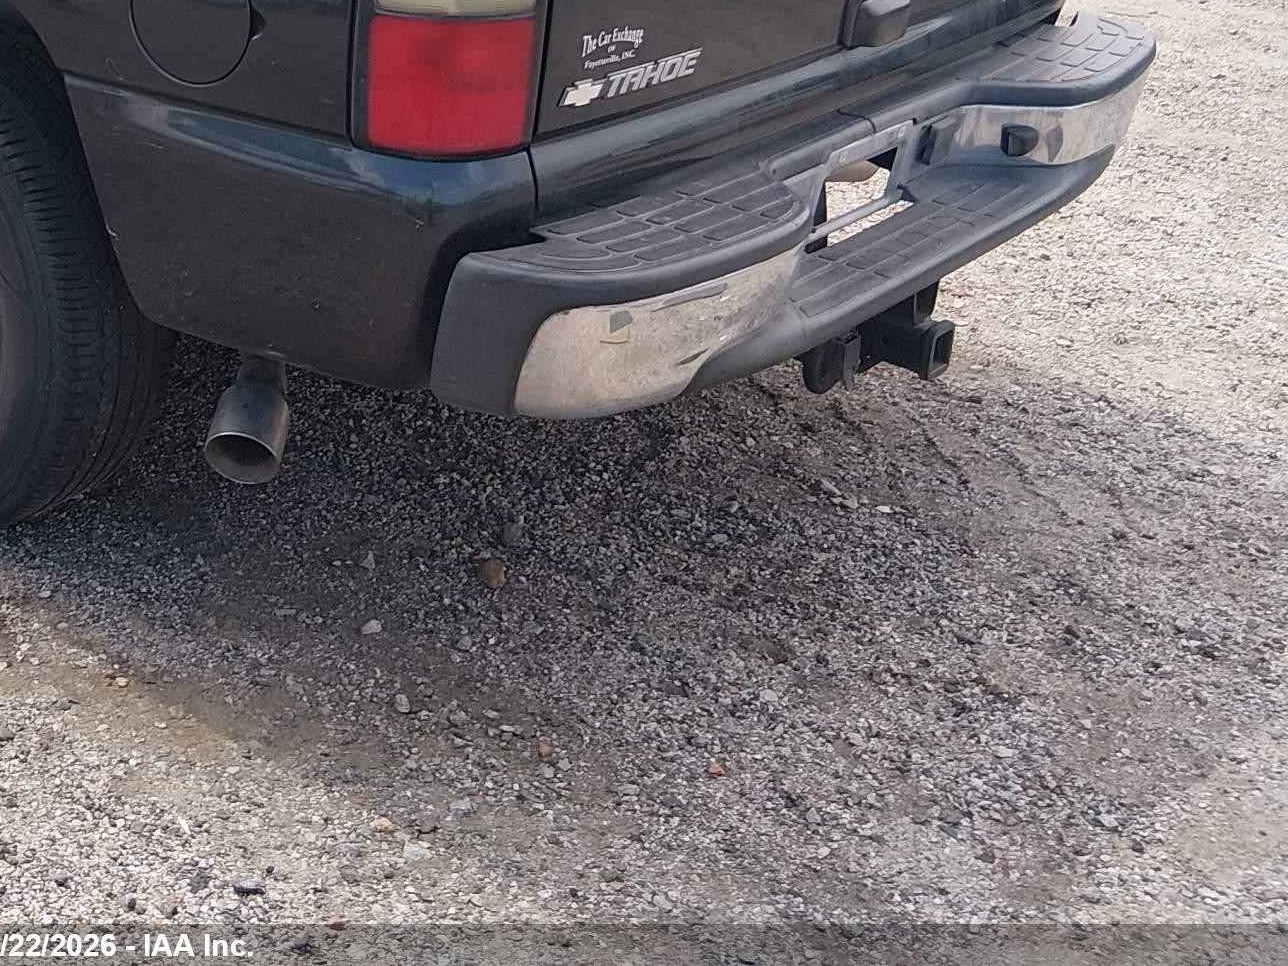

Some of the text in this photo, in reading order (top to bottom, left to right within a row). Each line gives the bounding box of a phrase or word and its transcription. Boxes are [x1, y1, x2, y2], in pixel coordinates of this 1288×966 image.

[581, 26, 644, 57] The Car Exchange
[606, 48, 703, 98] TAHOE
